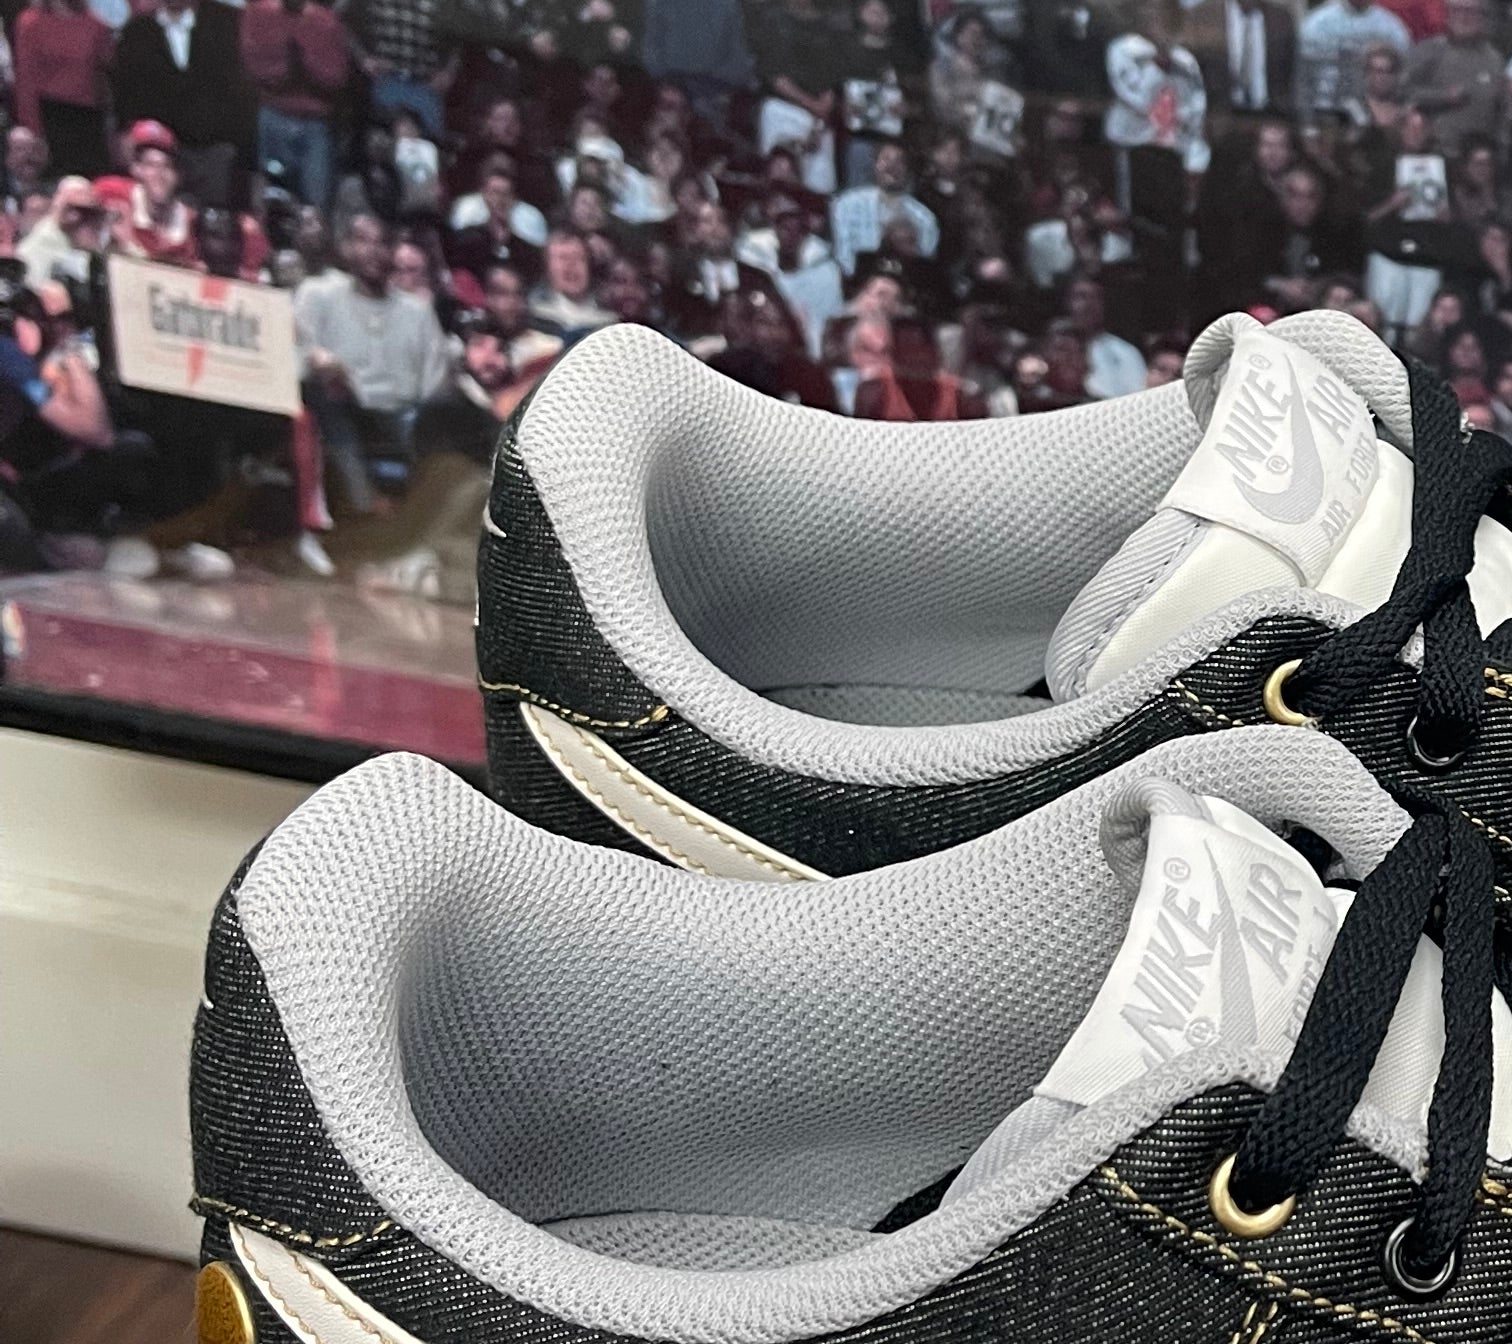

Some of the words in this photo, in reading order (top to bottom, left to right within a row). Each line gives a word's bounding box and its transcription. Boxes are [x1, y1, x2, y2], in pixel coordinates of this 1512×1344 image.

[1214, 370, 1294, 485] NIKE
[1305, 373, 1356, 447] AIR
[1119, 884, 1226, 1064] NIKE
[1240, 862, 1303, 986] AIR
